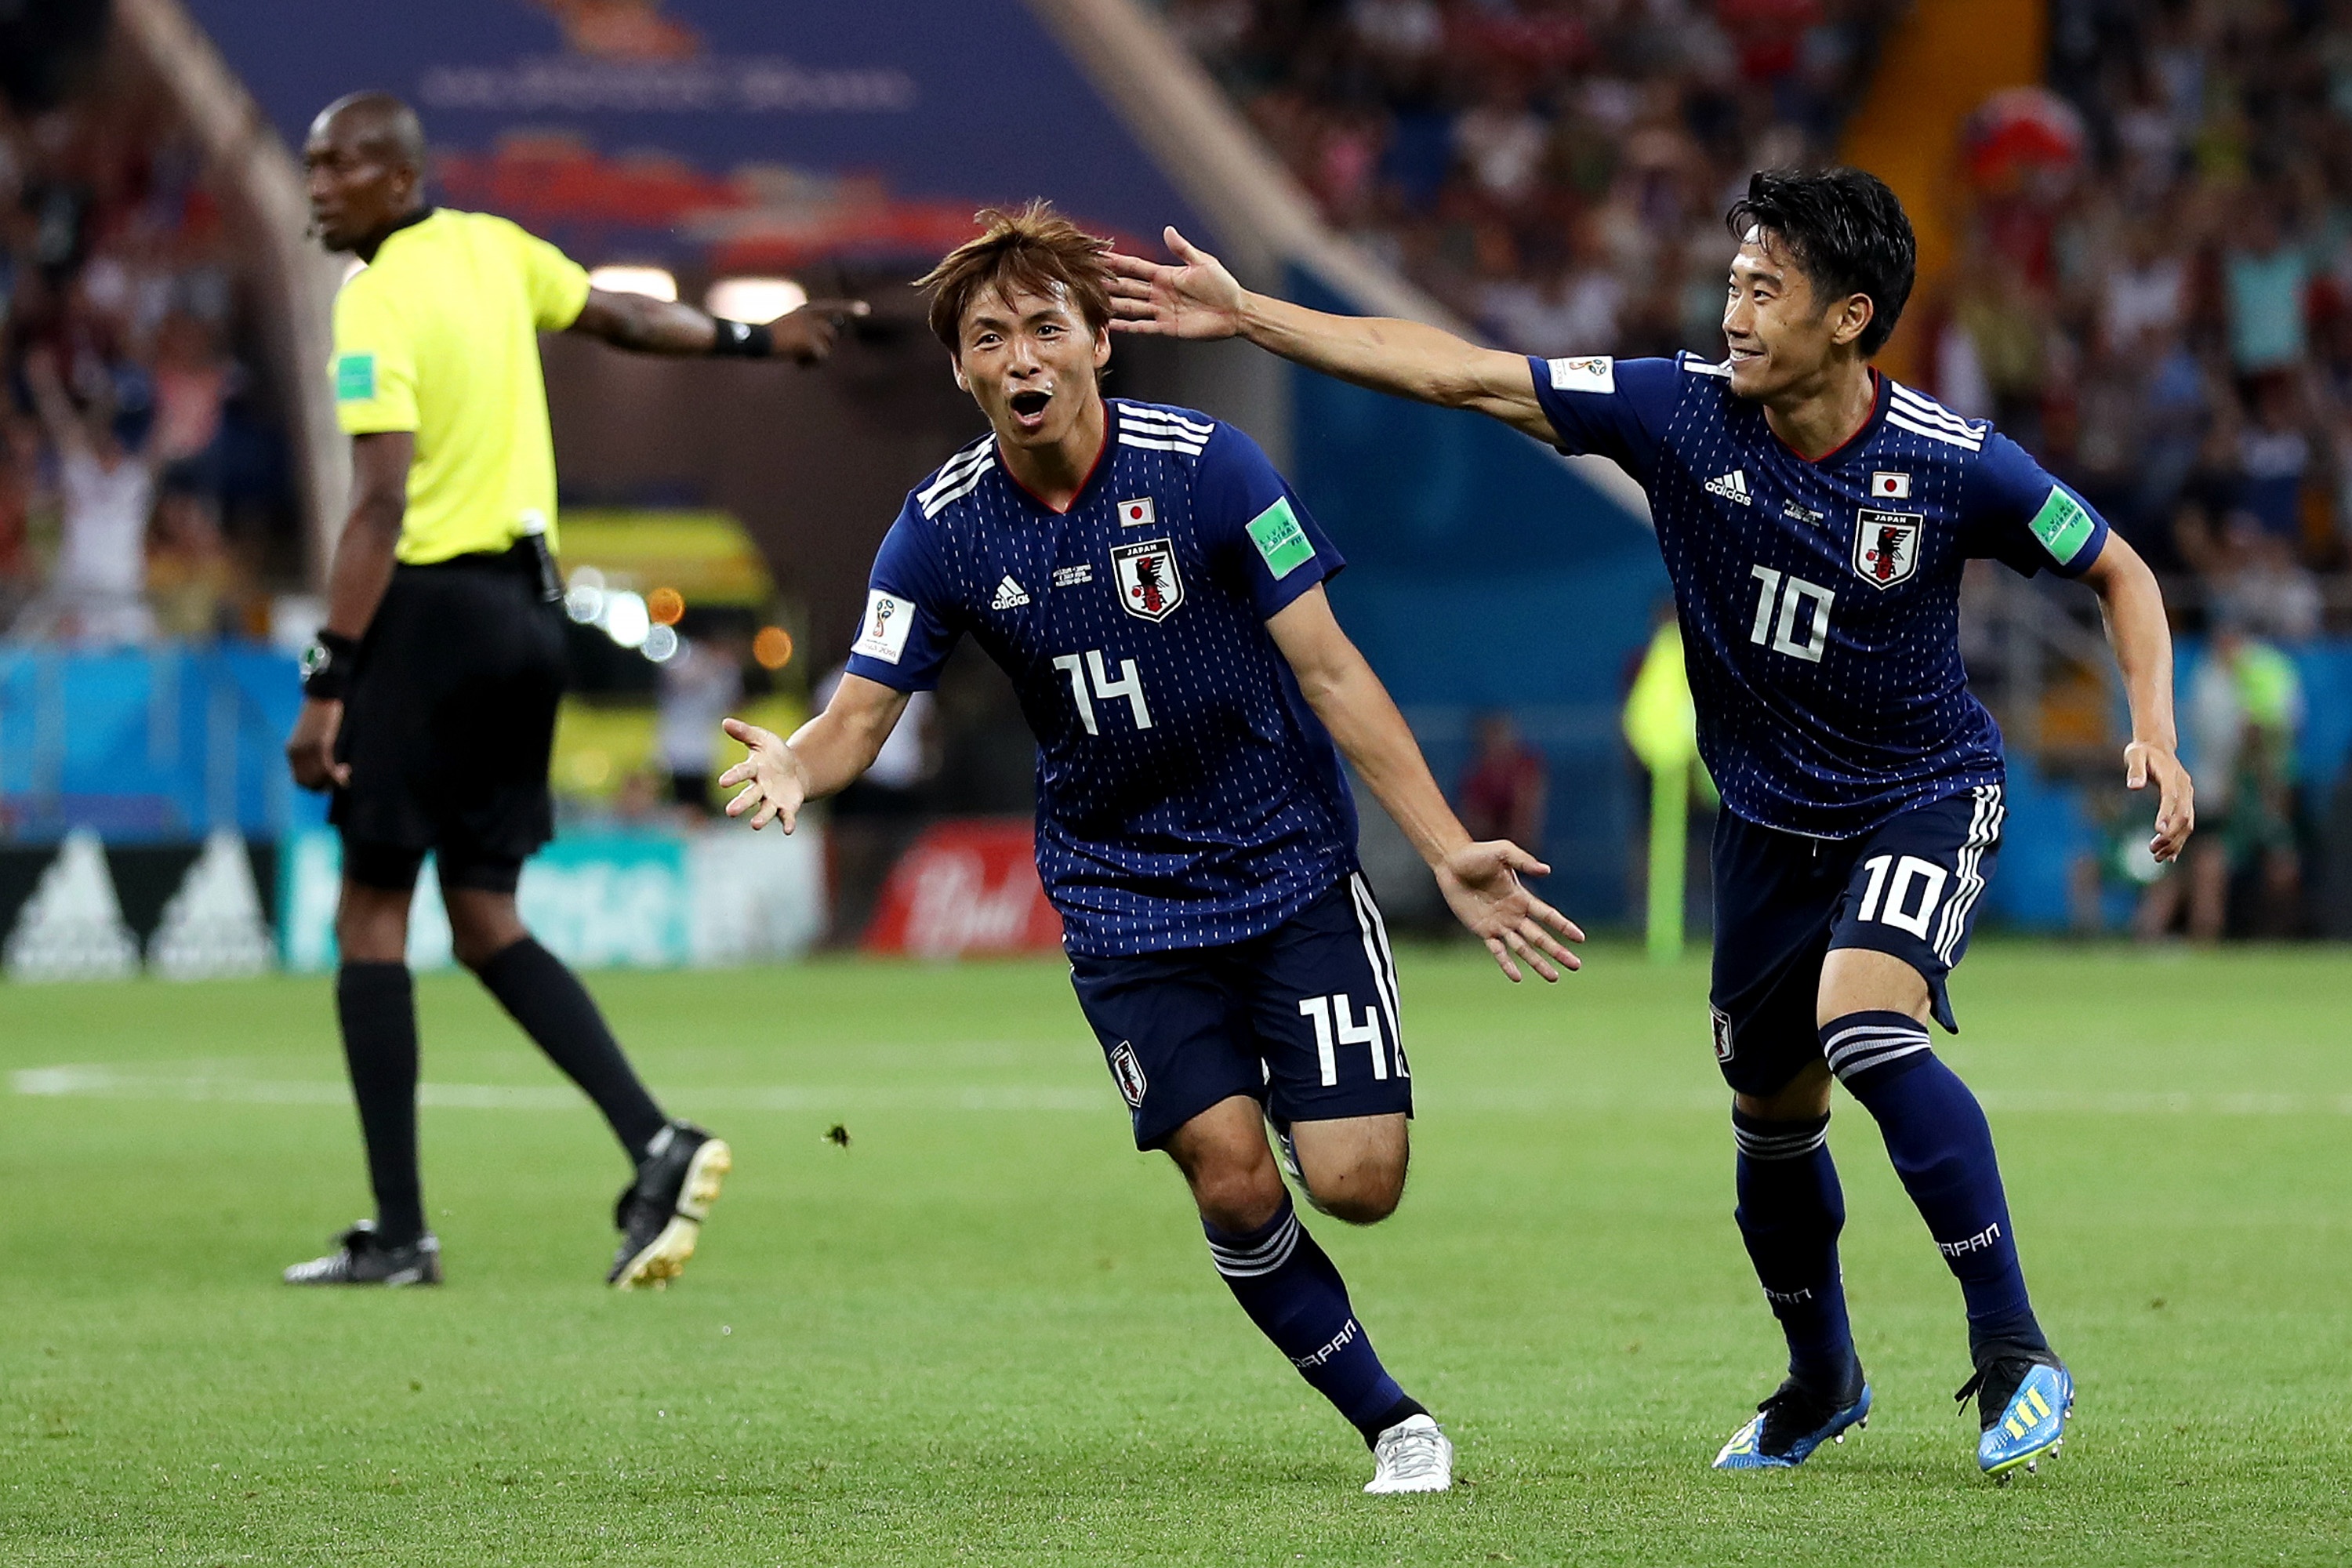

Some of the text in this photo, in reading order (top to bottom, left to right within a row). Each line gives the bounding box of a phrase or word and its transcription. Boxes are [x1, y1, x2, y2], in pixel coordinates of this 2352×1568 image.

[1705, 481, 1751, 506] adidas
[1875, 514, 1907, 524] JAPAN
[1127, 544, 1157, 557] JAPAN
[991, 593, 1030, 611] adidas
[1751, 564, 1835, 663] 10
[1052, 649, 1152, 735] 14
[1857, 855, 1948, 941] 10
[1298, 993, 1388, 1087] 14
